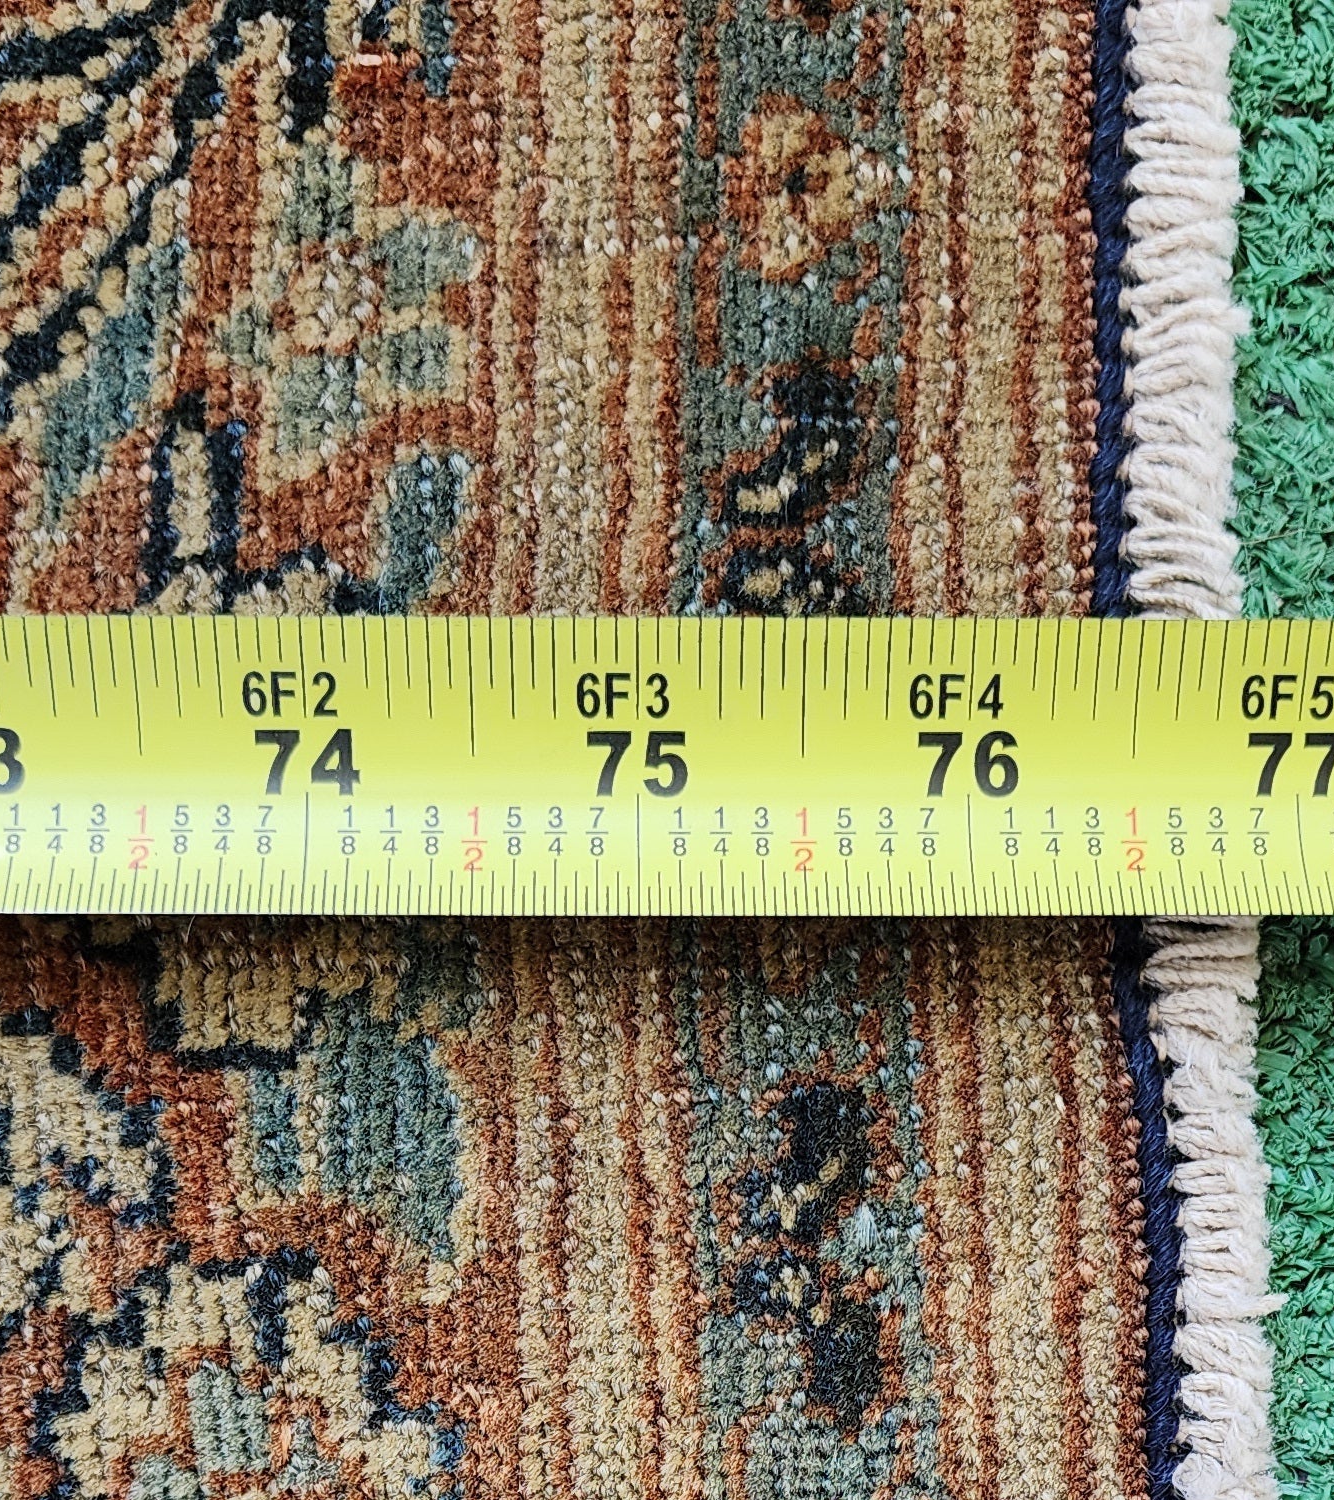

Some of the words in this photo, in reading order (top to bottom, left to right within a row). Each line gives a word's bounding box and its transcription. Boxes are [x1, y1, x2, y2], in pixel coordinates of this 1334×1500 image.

[254, 729, 361, 796] 74
[586, 731, 688, 796] 75
[917, 731, 1019, 797] 76
